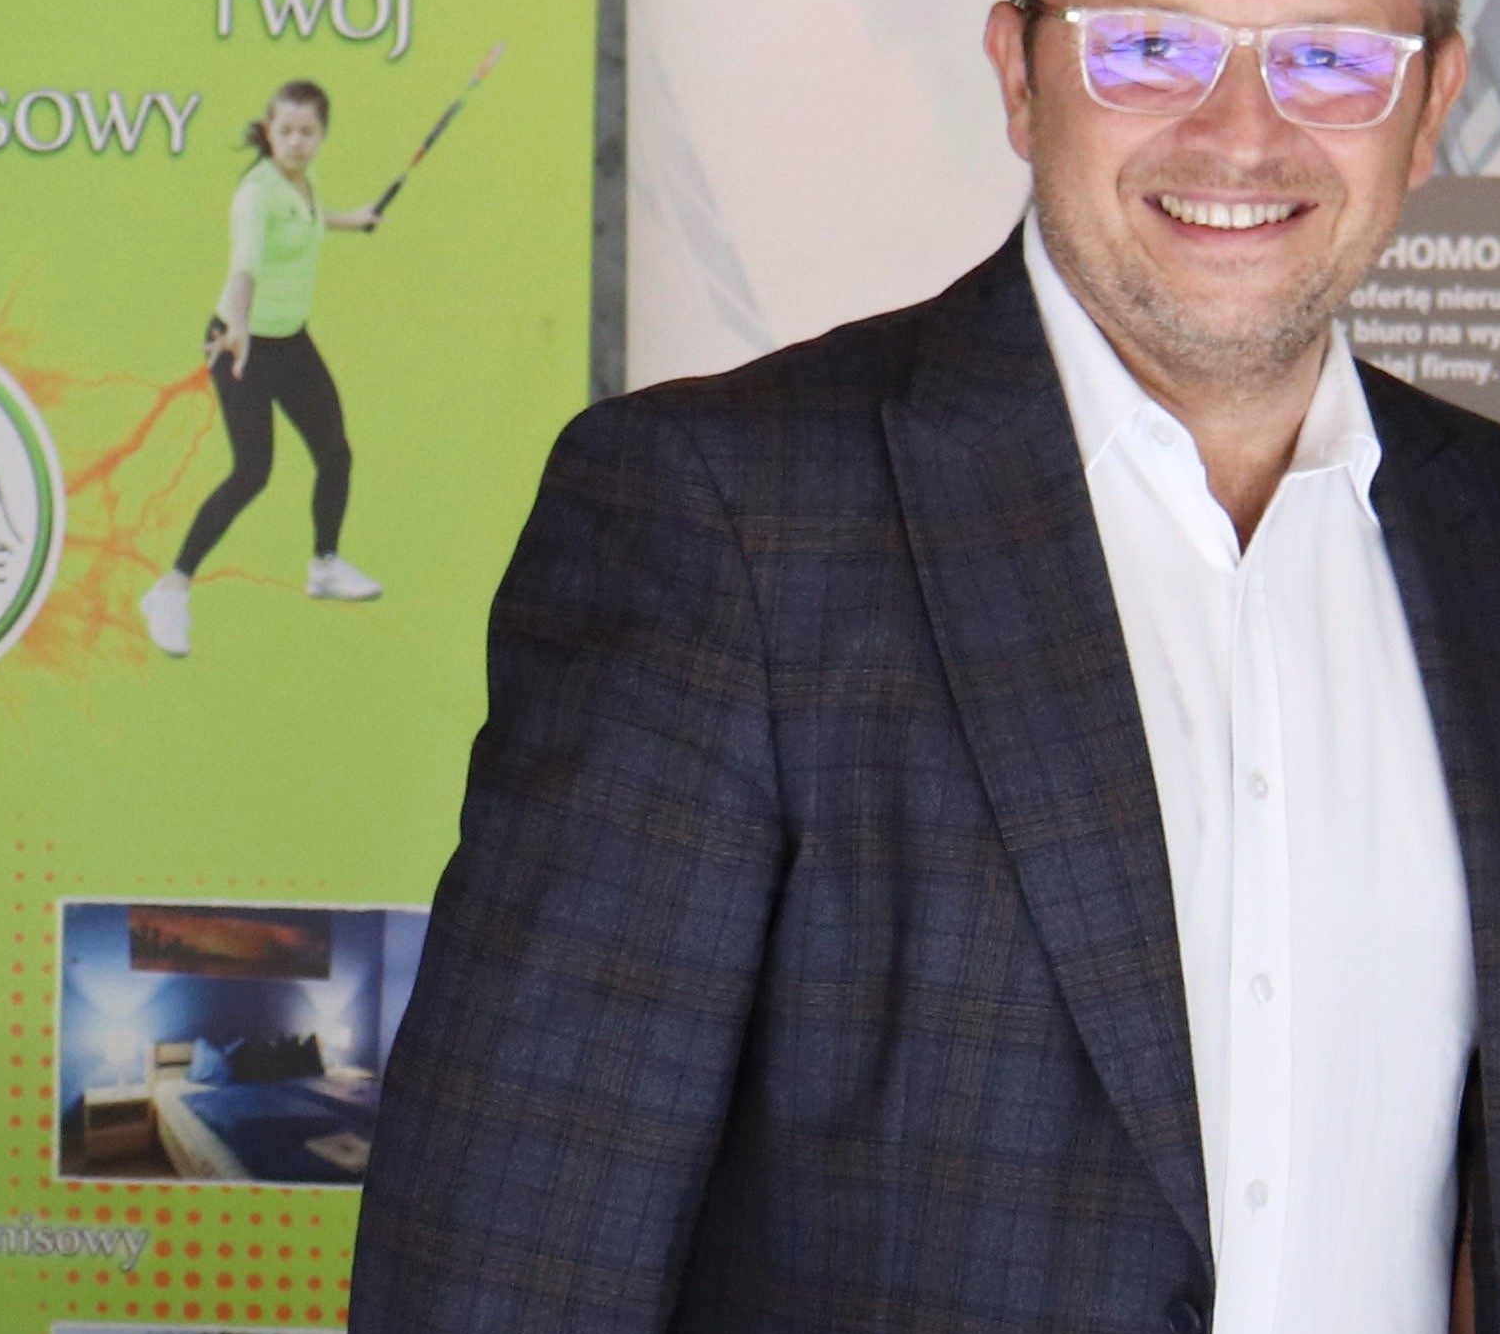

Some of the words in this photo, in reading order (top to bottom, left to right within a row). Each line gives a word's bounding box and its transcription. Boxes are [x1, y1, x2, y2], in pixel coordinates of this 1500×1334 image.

[1350, 283, 1431, 316] ofertę
[1354, 320, 1423, 345] biuro
[1427, 323, 1462, 344] na
[1421, 353, 1499, 386] firmy.
